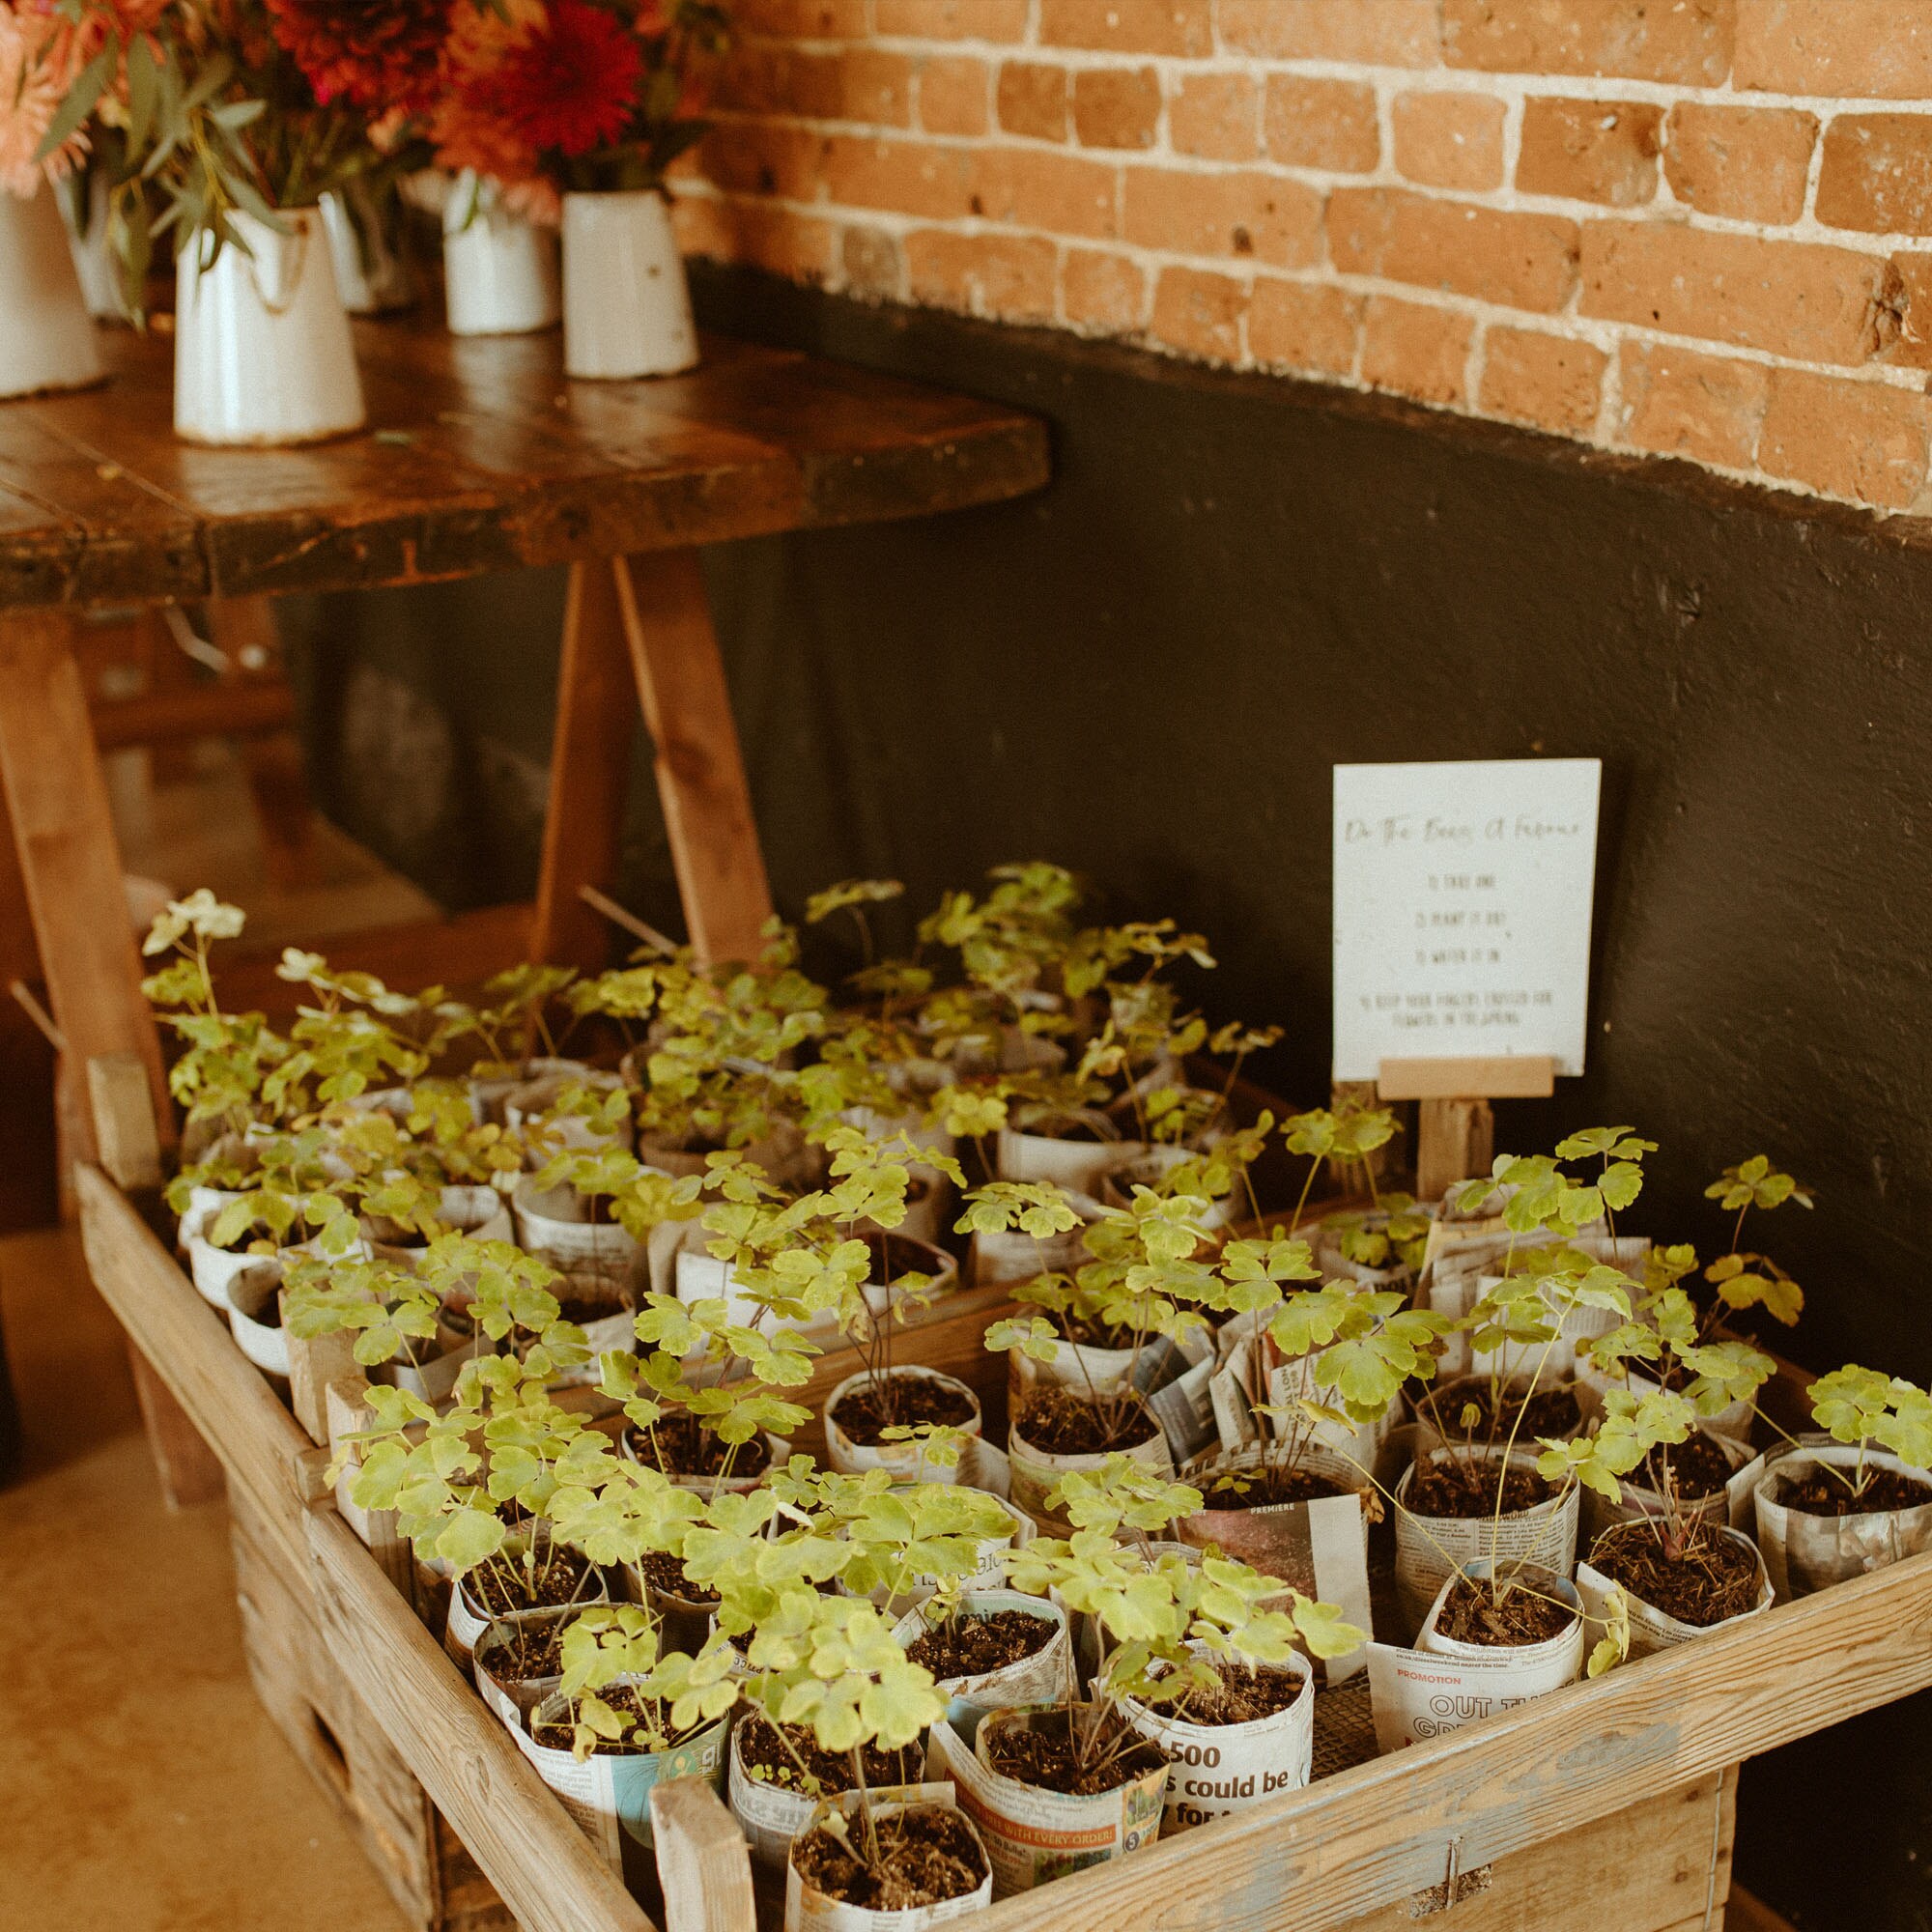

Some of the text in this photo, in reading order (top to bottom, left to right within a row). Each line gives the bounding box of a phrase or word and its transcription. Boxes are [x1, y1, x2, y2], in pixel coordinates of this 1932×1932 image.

[1397, 1668, 1462, 1685] PROMOTION
[1430, 1694, 1492, 1719] OUT
[1184, 1775, 1256, 1798] could
[1263, 1771, 1289, 1793] be
[1176, 1802, 1215, 1826] for
[1005, 1824, 1032, 1839] WITH
[1034, 1832, 1069, 1845] EVERY
[1072, 1830, 1114, 1845] ORDER!
